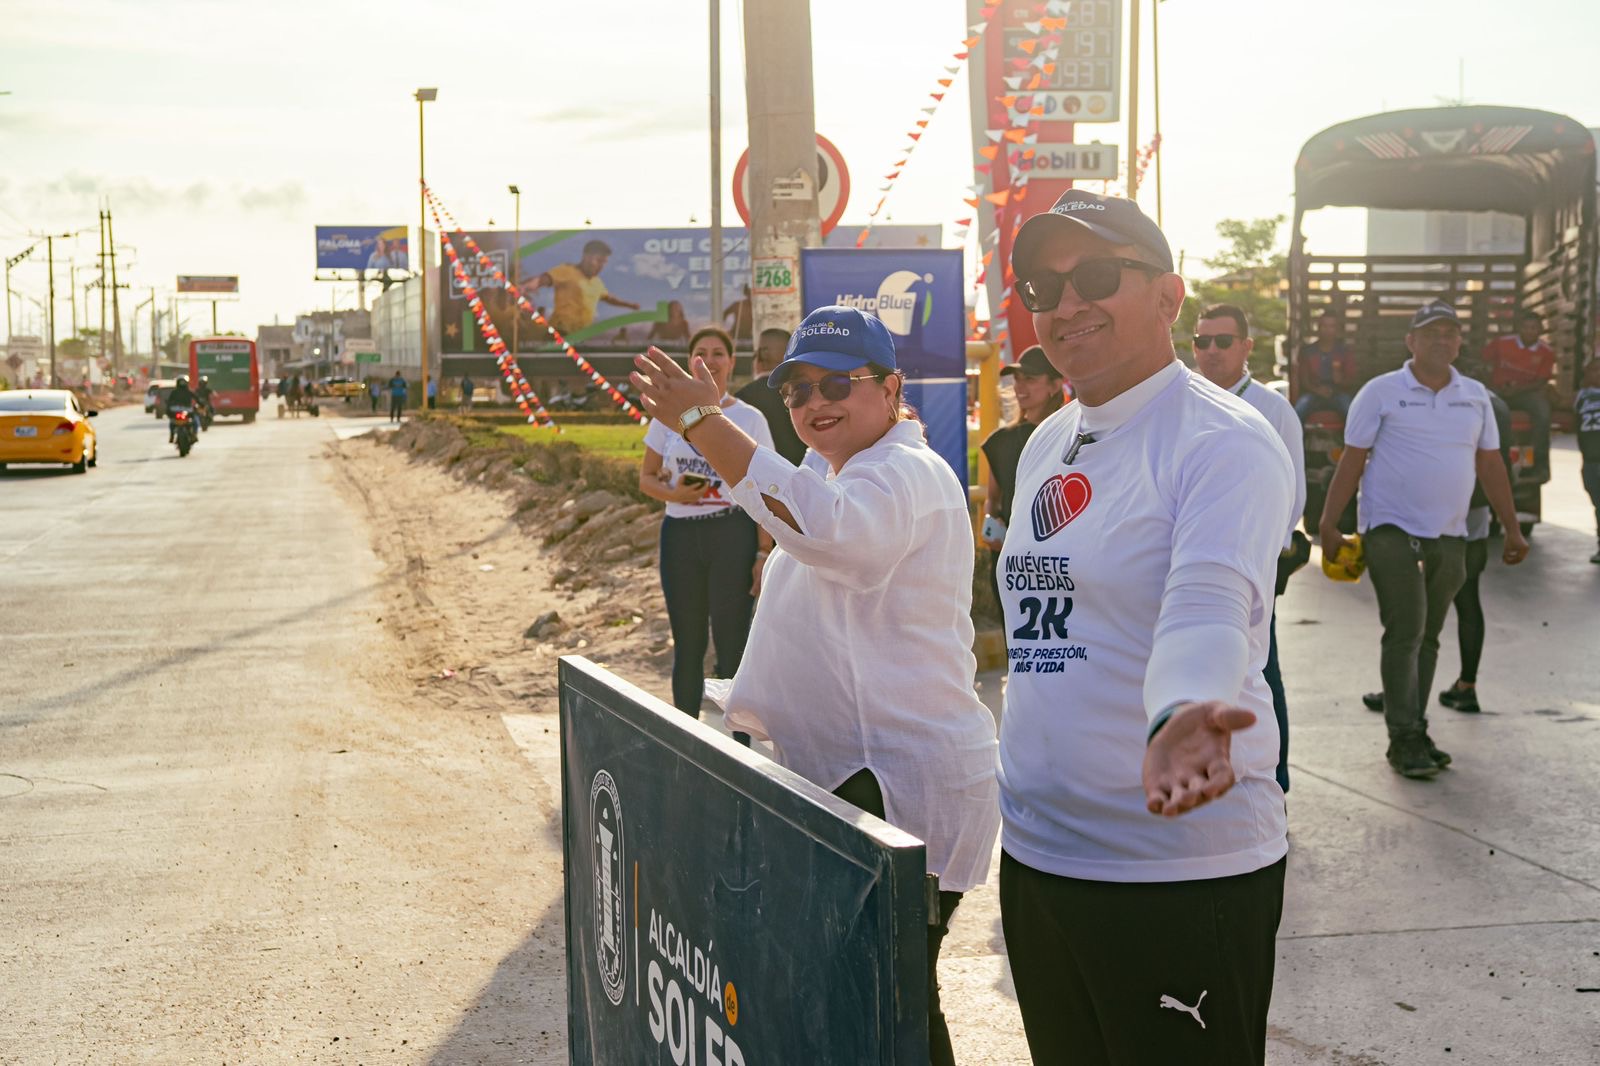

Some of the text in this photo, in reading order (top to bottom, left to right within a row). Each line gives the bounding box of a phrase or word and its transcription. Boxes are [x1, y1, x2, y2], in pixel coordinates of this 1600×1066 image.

[643, 237, 694, 254] QUE
[801, 326, 850, 339] SOLEDAD
[1006, 551, 1070, 575] MUÉVETE
[1006, 573, 1076, 592] SOLEDAD
[1013, 596, 1074, 640] 2K
[1032, 644, 1088, 661] PRESIÓN,
[1036, 661, 1065, 673] VIDA
[649, 907, 723, 1013] ALCALDÍA
[727, 992, 735, 1015] de
